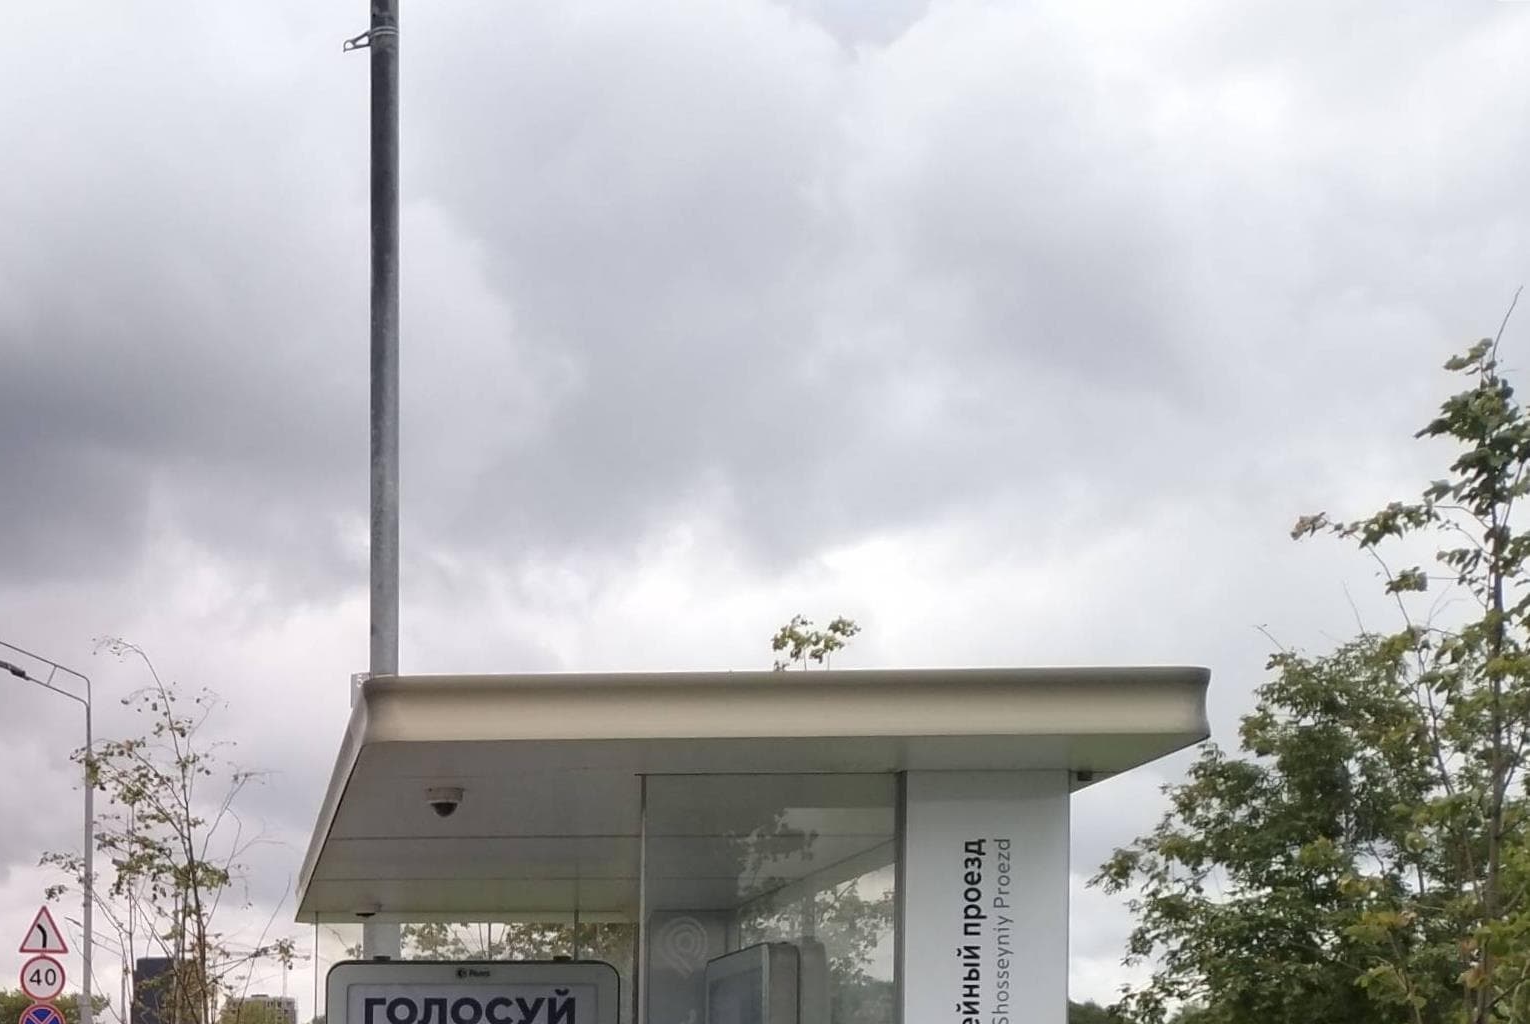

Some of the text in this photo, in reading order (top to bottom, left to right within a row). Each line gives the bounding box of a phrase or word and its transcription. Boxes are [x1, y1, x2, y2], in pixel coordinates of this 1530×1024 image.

[963, 838, 987, 936] проезд
[993, 838, 1011, 908] Proezd
[29, 968, 57, 986] 40
